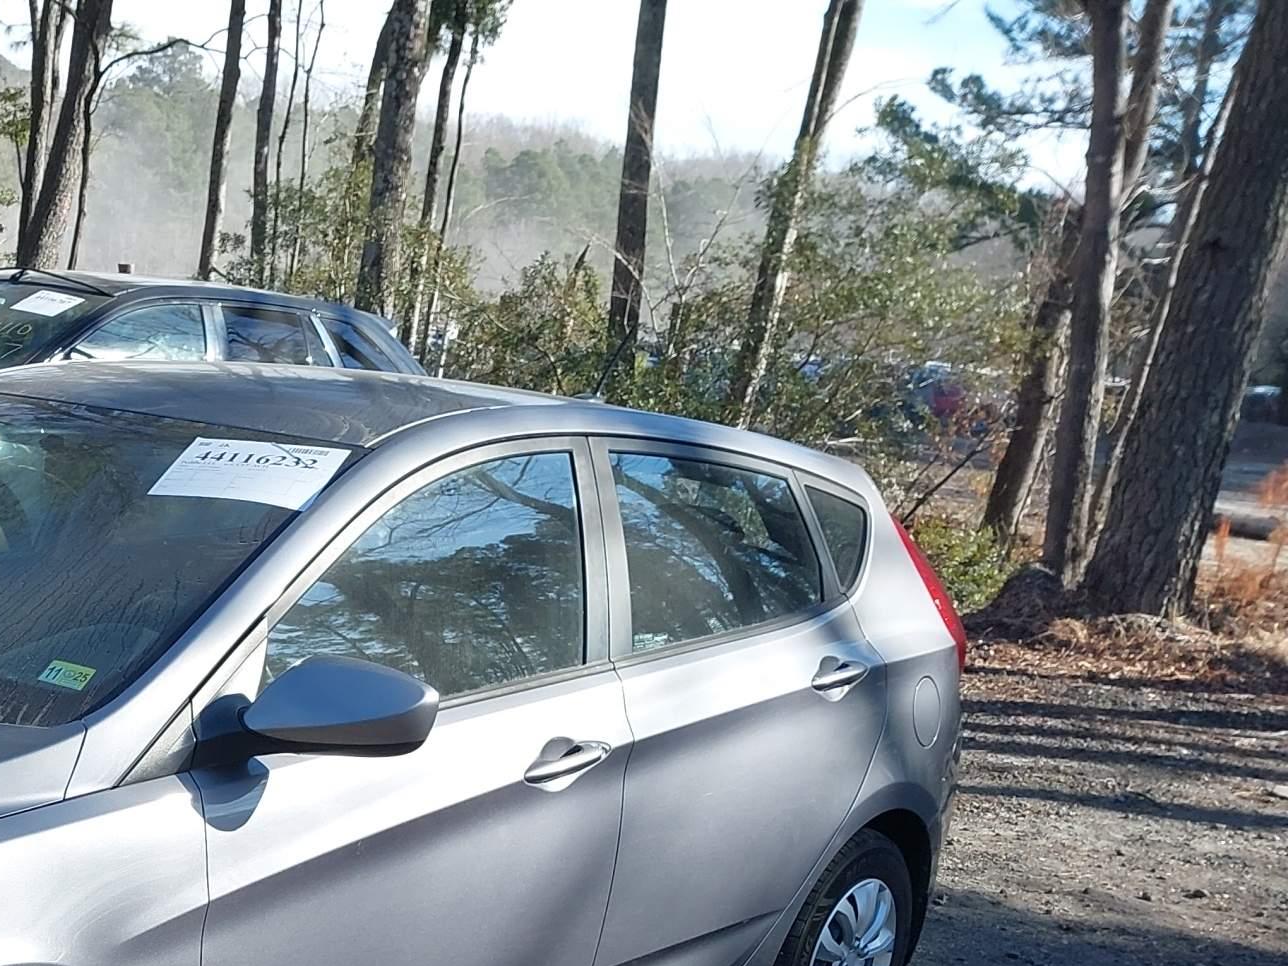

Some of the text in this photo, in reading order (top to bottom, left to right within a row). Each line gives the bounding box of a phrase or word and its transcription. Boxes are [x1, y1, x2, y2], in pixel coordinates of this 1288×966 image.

[195, 450, 318, 470] 44116232
[45, 665, 90, 682] 11 25
